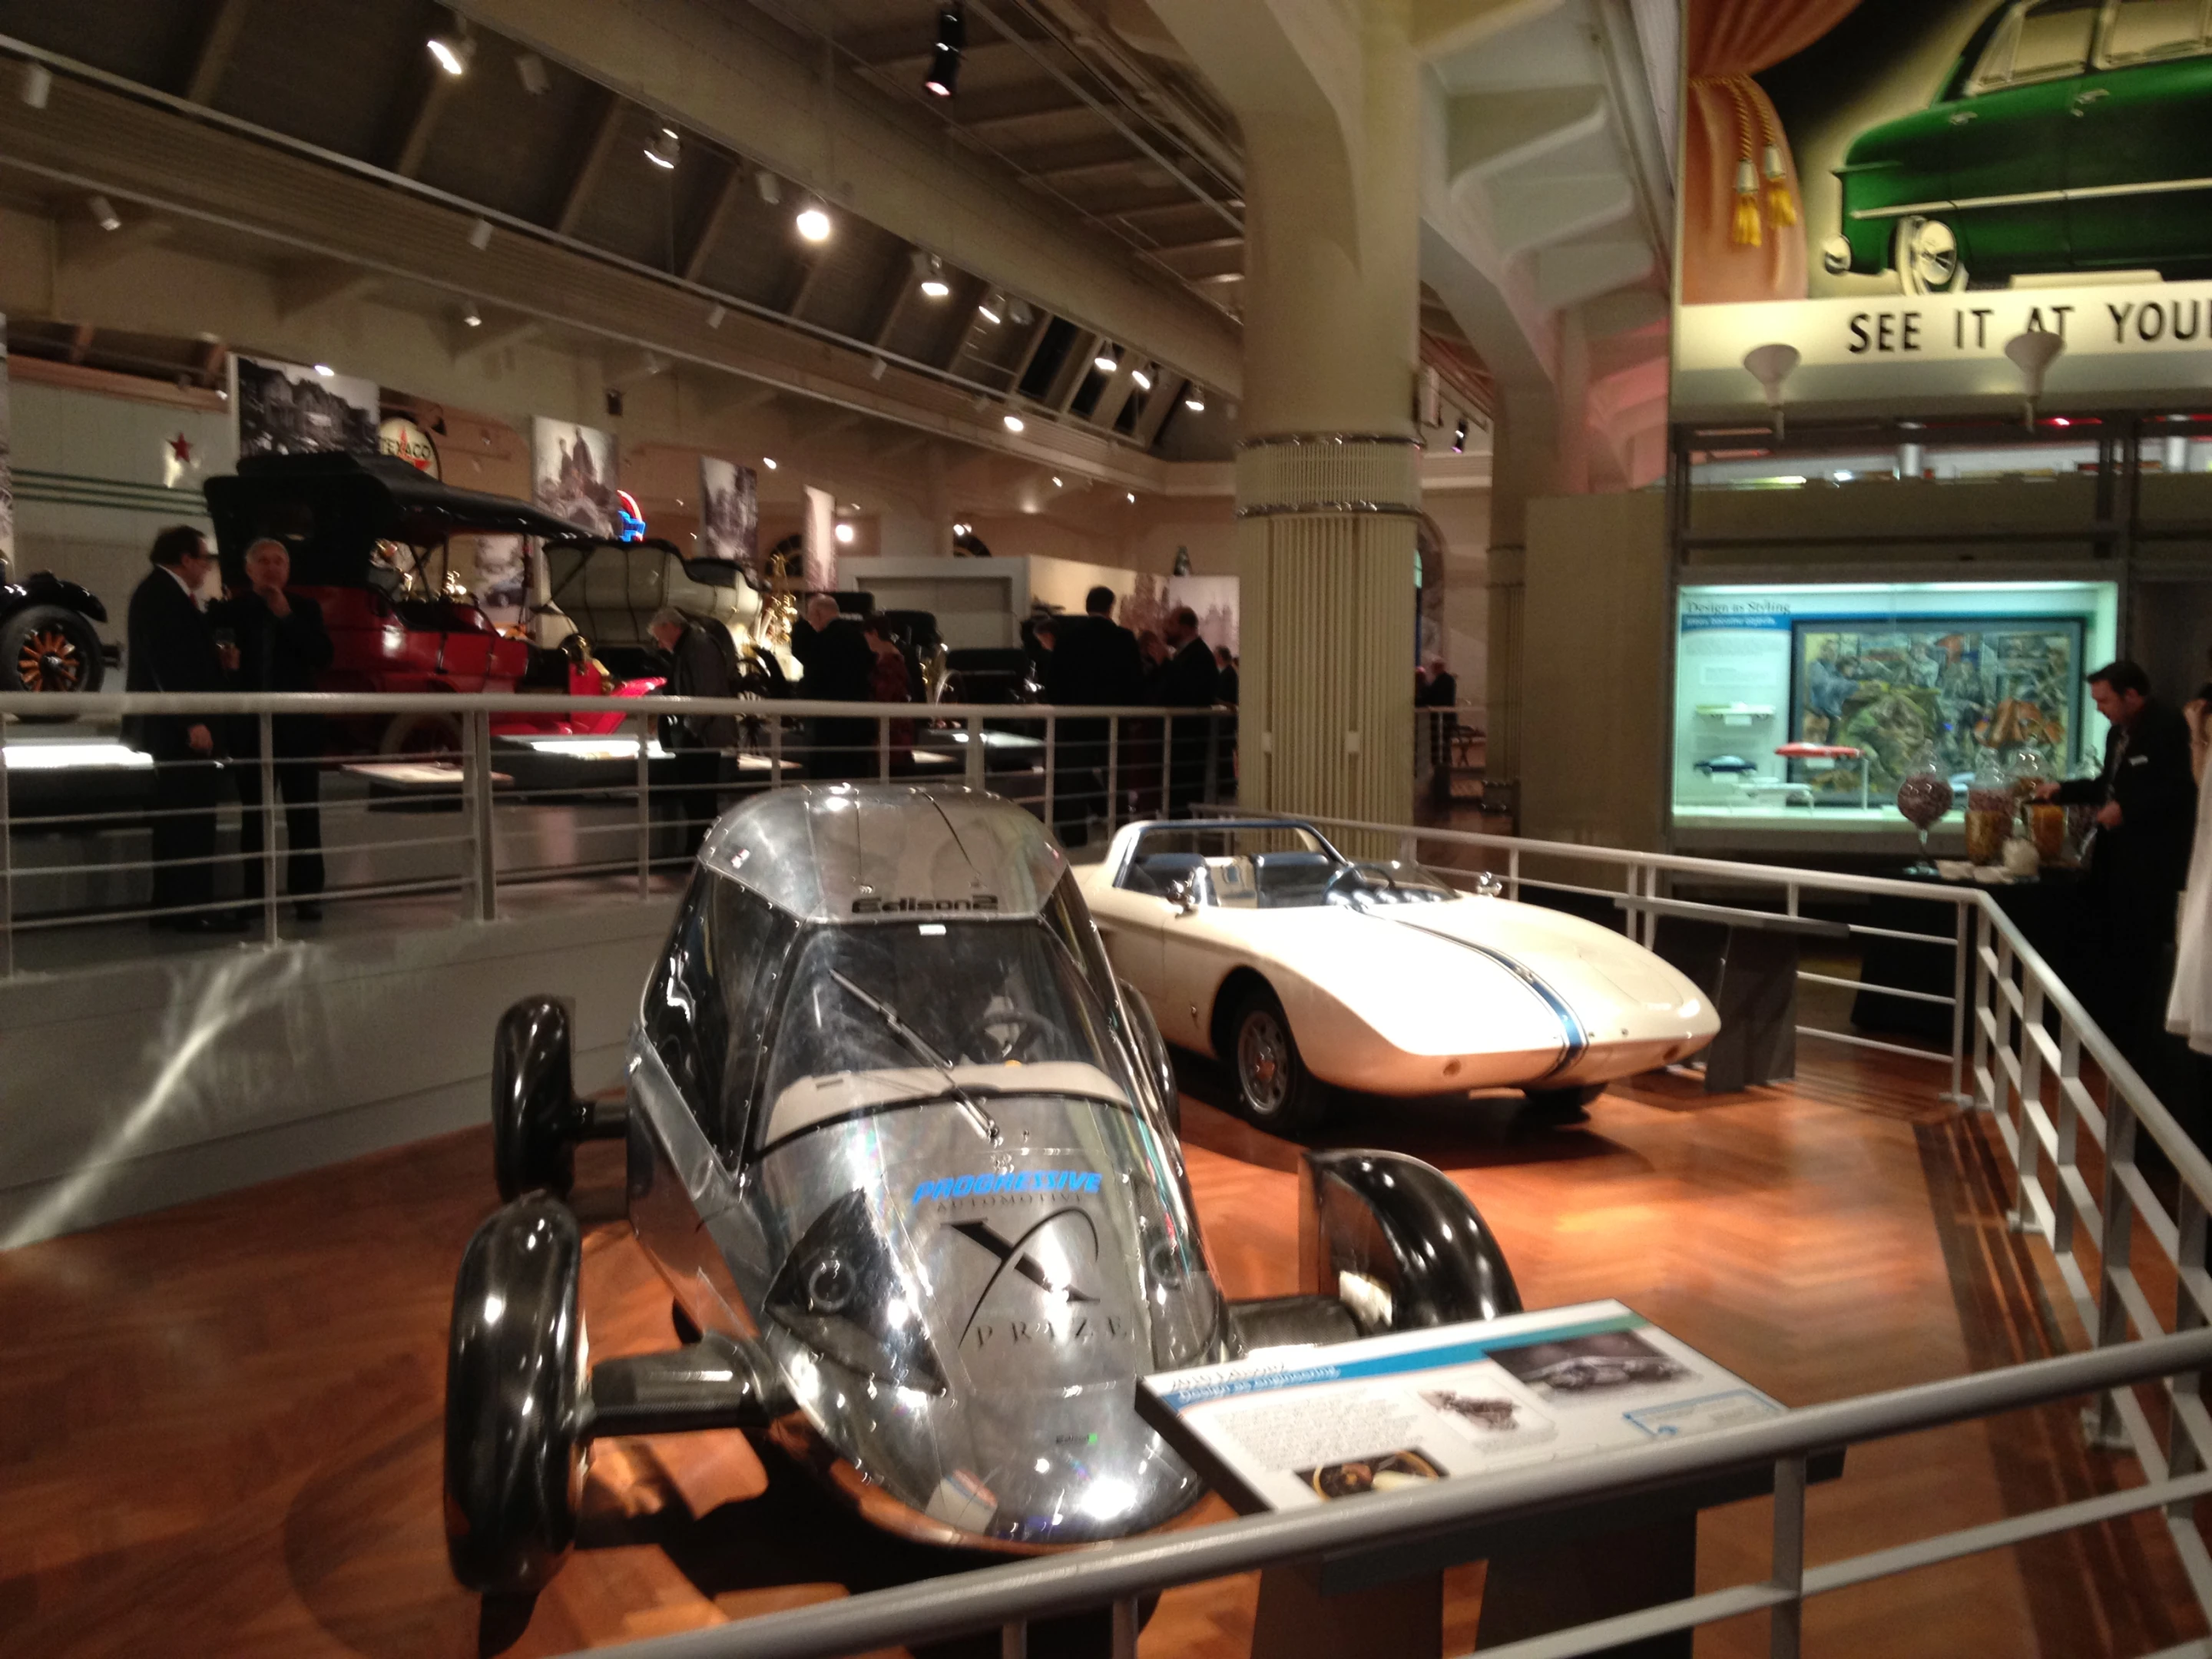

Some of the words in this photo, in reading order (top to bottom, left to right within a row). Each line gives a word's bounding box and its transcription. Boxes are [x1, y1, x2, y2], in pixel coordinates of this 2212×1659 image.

[1848, 312, 1922, 353] SEE
[1955, 308, 1995, 349] IT
[2106, 299, 2212, 343] YOU
[1687, 601, 1729, 615] Design
[1747, 599, 1791, 615] Styling
[852, 895, 998, 913] Edison2
[912, 1170, 1104, 1206] PROGRESSIVE
[936, 1193, 1084, 1213] AUTOMOTIVE
[975, 1315, 1128, 1350] PRIZE
